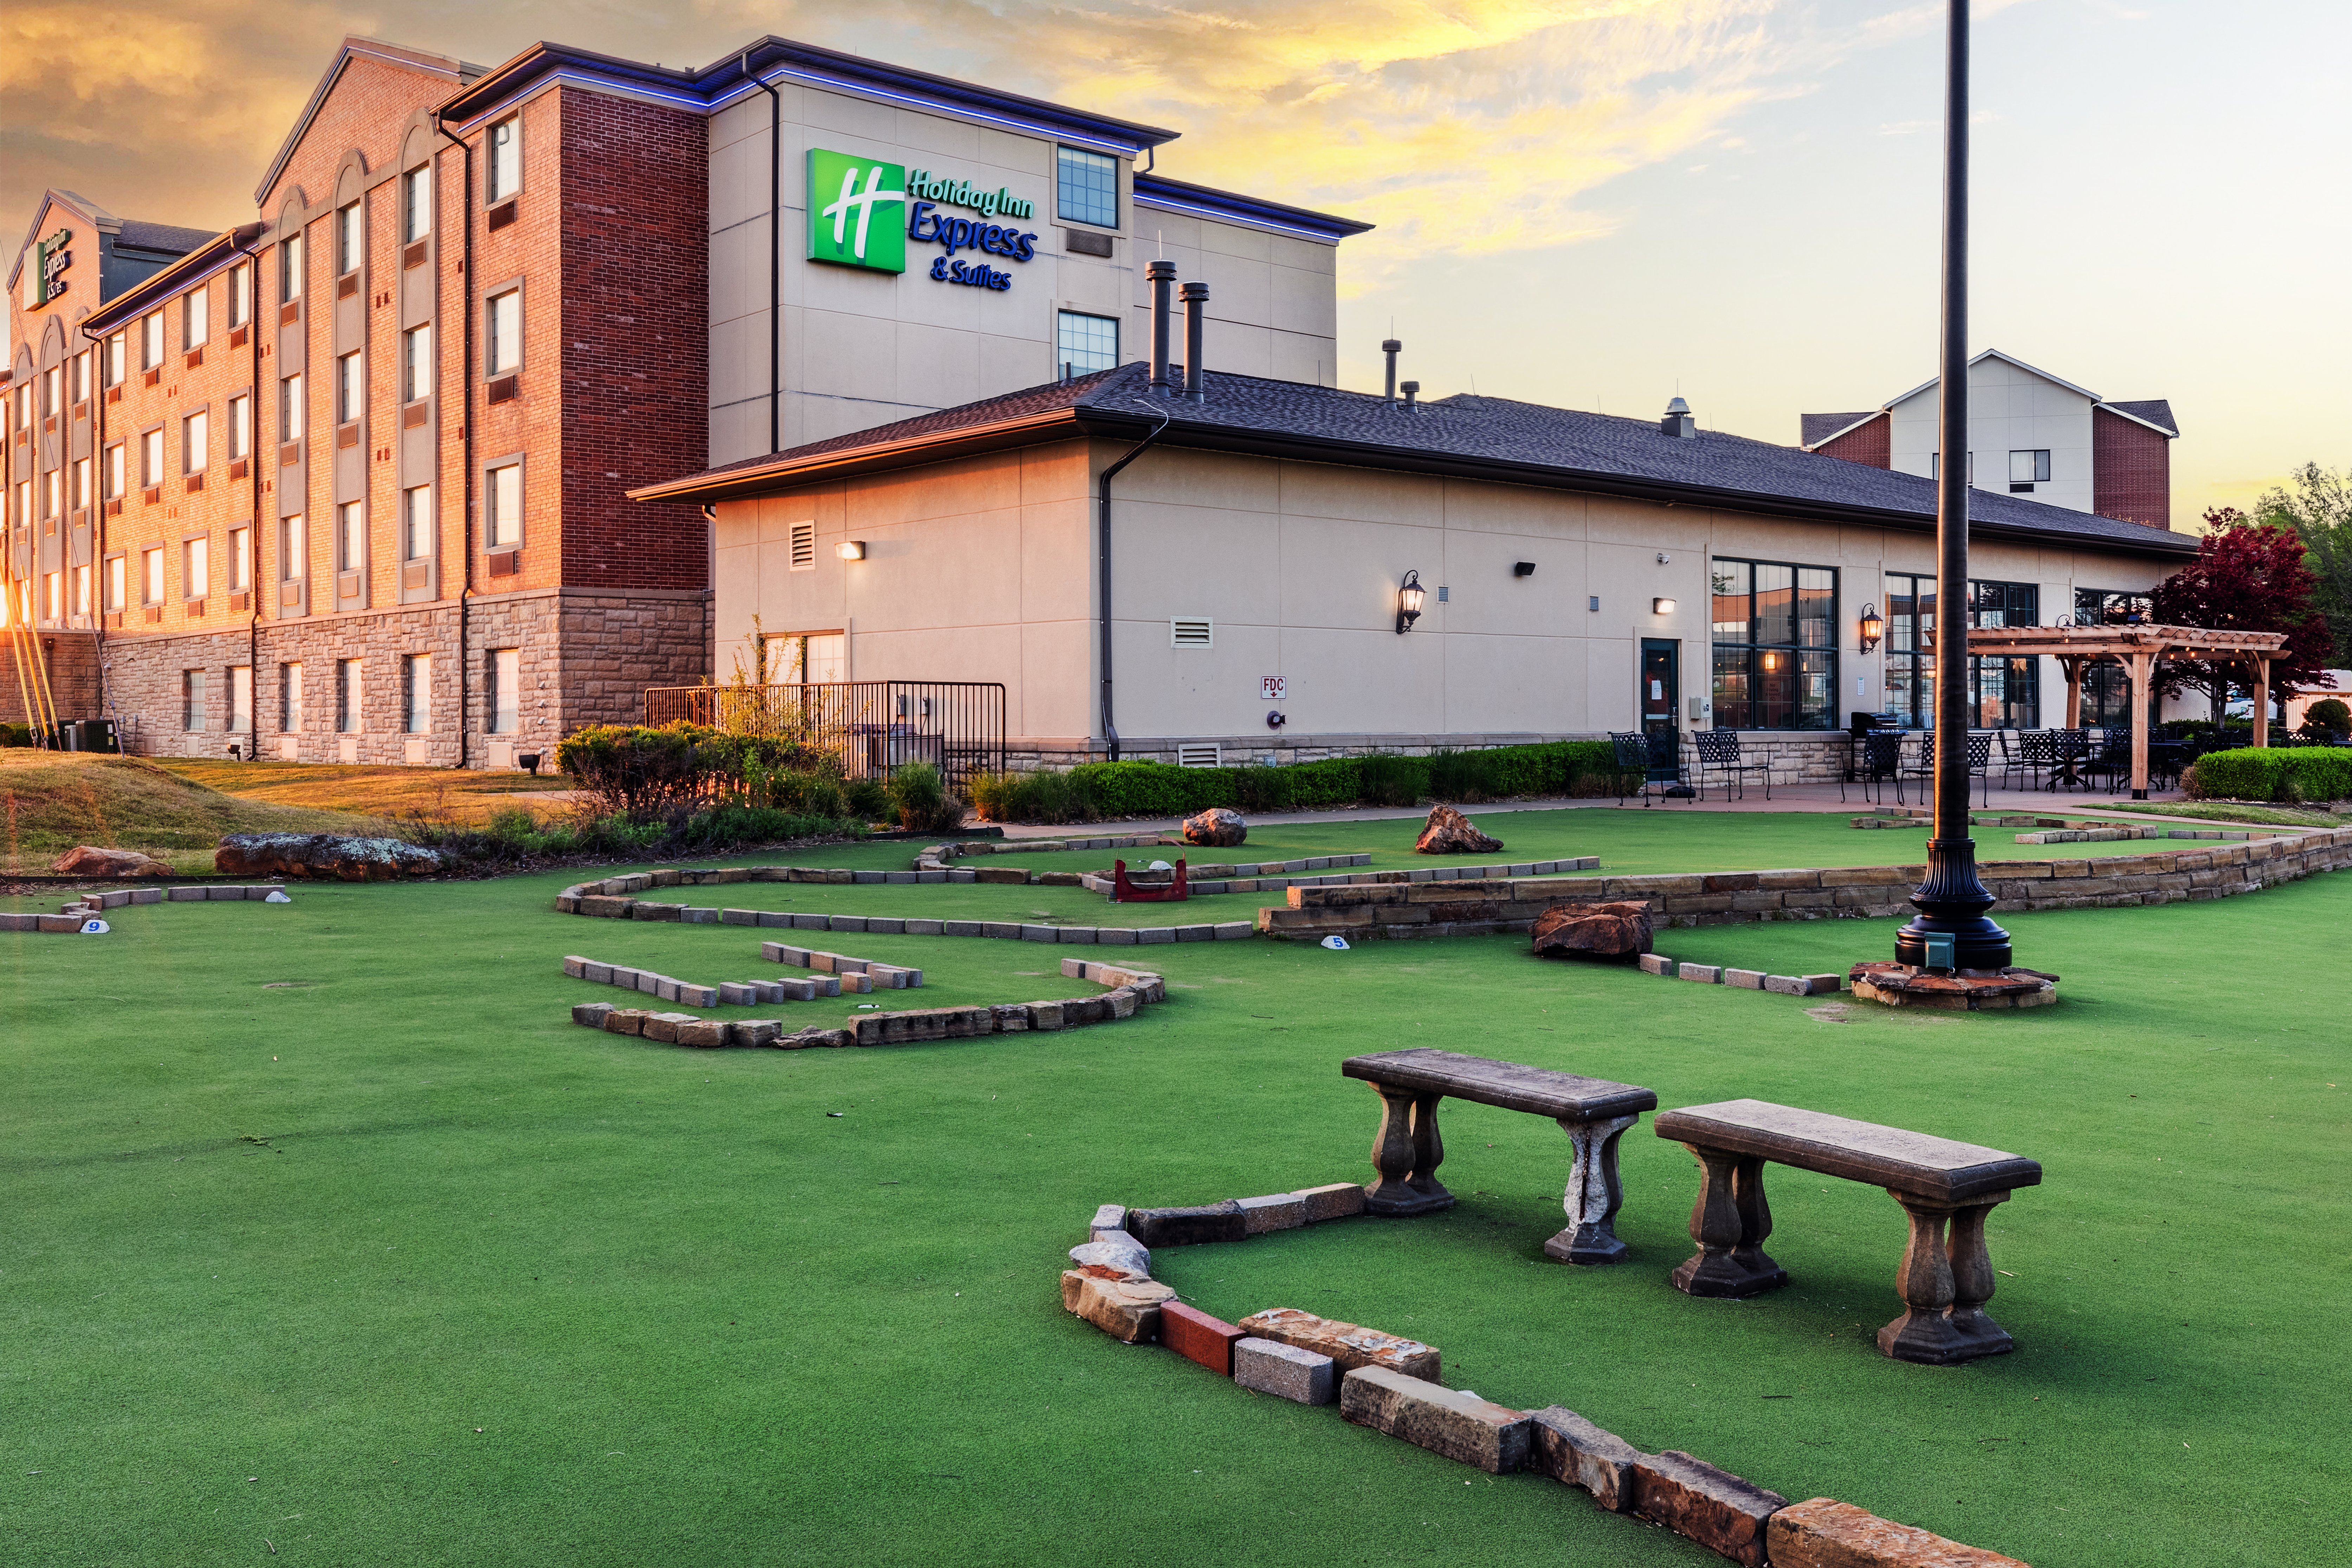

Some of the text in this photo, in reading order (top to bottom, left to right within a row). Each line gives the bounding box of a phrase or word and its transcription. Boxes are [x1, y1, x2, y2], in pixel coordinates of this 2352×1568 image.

[907, 169, 1034, 219] Holiday Inn
[909, 201, 1038, 261] Express
[44, 250, 66, 282] Express
[931, 256, 1012, 291] & Suites
[1264, 678, 1284, 691] FDC
[89, 922, 99, 931] 9
[1333, 937, 1343, 947] 5
